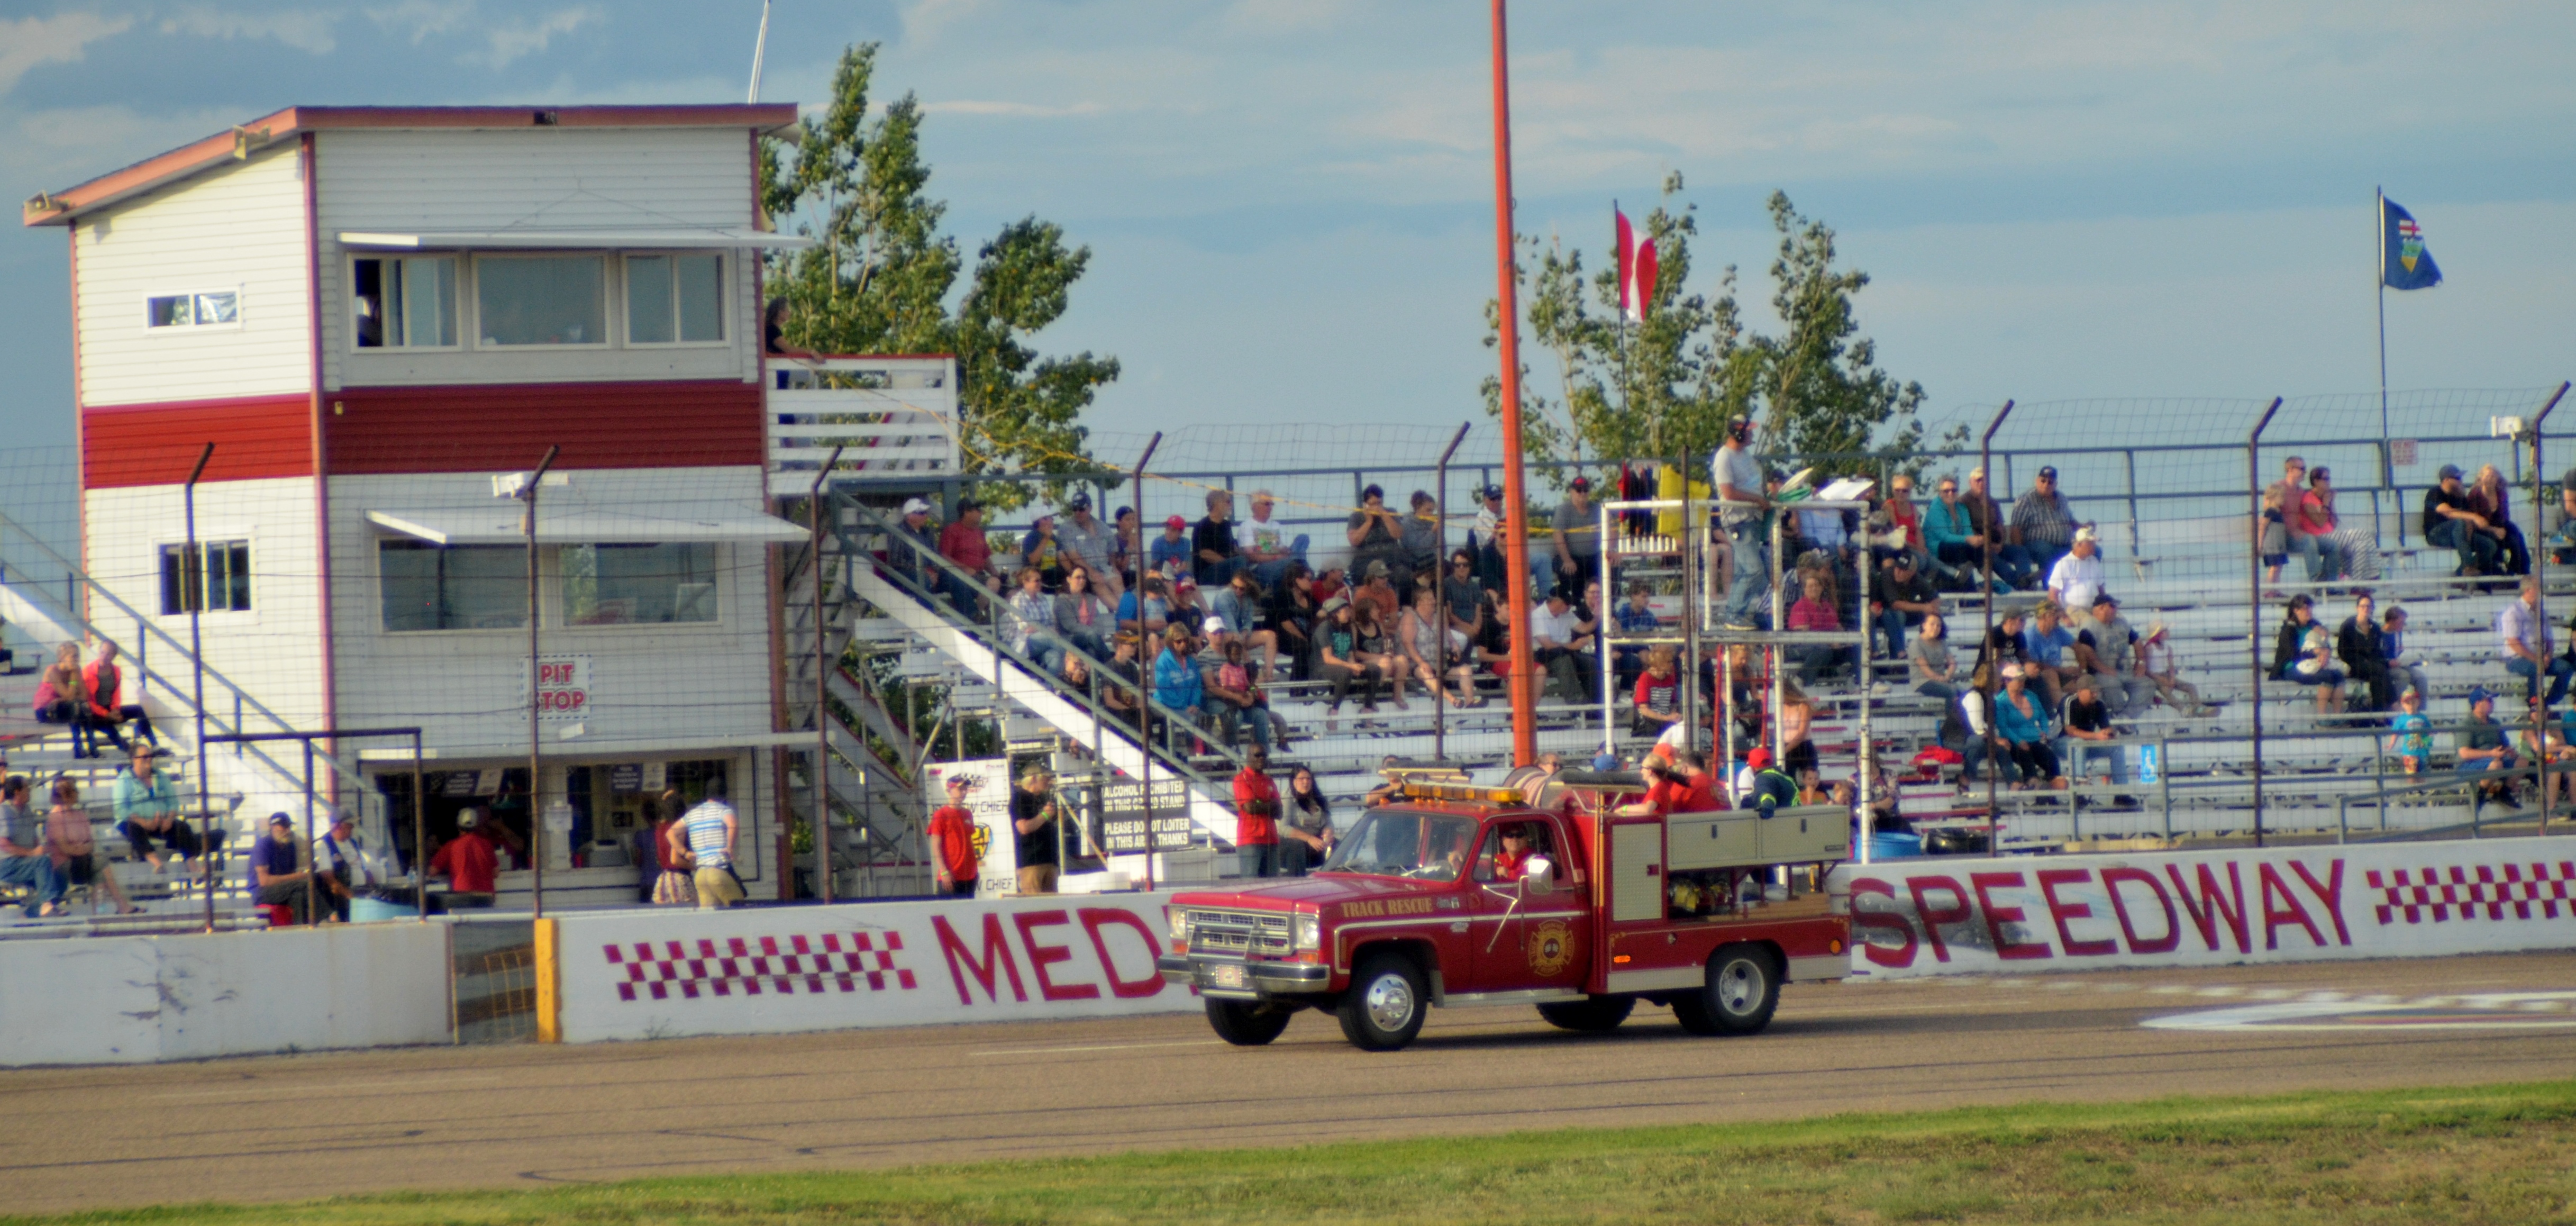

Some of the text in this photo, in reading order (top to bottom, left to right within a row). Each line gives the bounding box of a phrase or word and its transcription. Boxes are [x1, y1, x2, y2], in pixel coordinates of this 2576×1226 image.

[540, 663, 574, 684] PIT
[1140, 780, 1185, 795] POHIBITED
[1104, 821, 1133, 835] PLEASE
[1133, 821, 1145, 833] DO
[1162, 818, 1190, 831] LOITER
[1106, 837, 1115, 849] IN
[1115, 836, 1134, 848] THIS
[1157, 832, 1188, 846] THANKS
[1341, 901, 1385, 918] TRACK
[1387, 897, 1433, 915] RESCUE
[1851, 858, 2352, 968] SPEEDWAY
